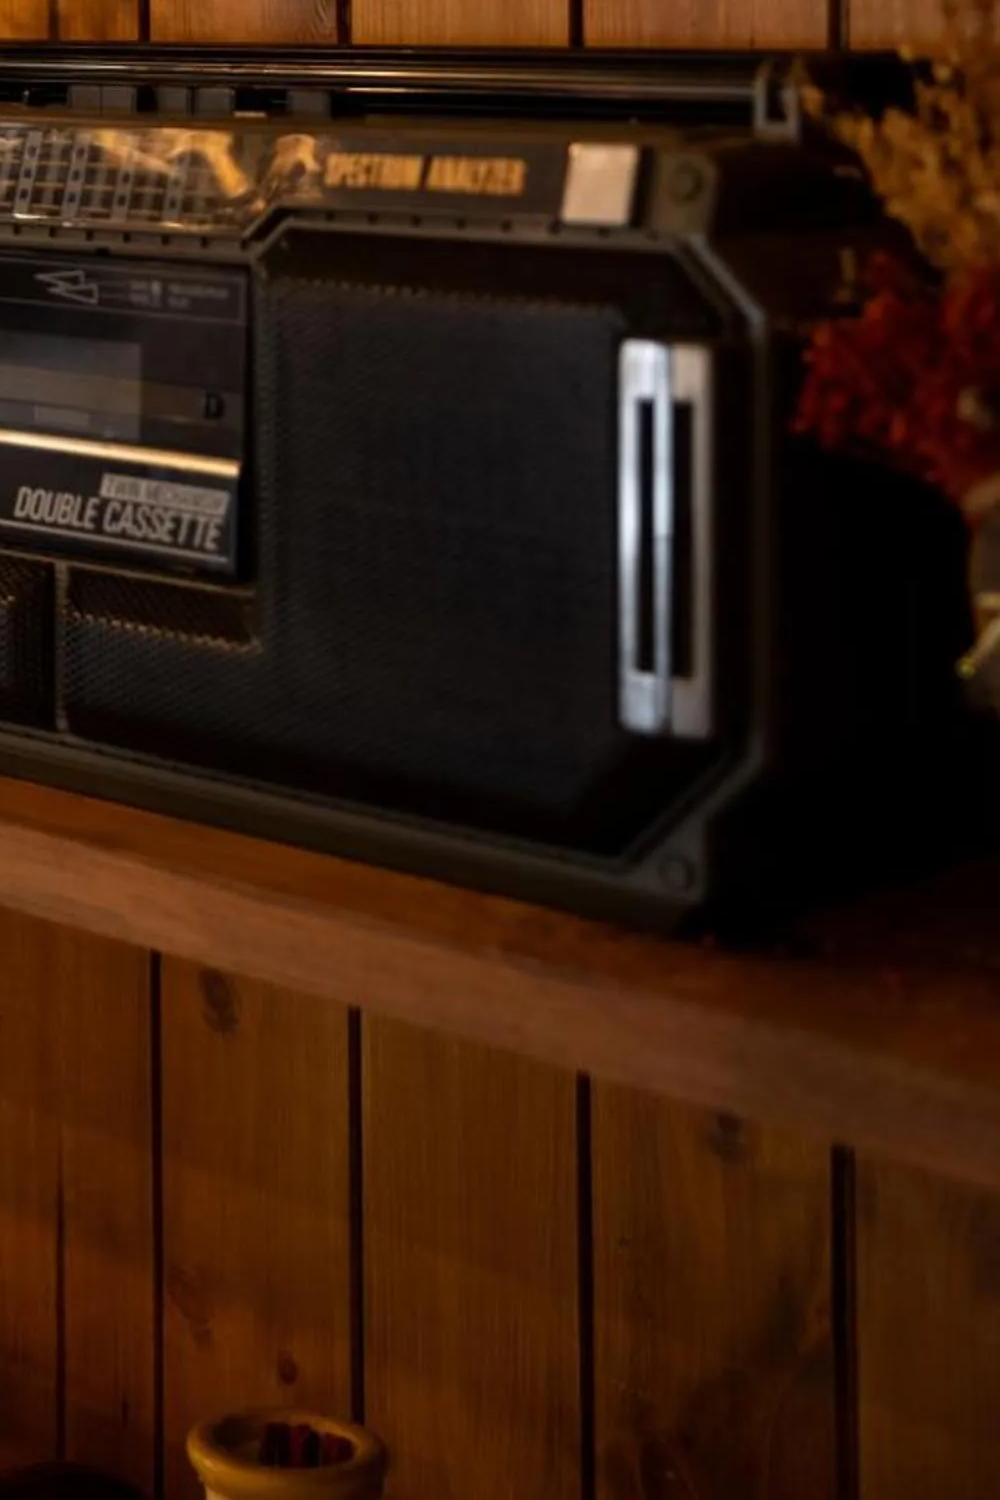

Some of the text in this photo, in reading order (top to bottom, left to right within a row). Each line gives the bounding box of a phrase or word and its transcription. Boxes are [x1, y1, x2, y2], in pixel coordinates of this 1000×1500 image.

[324, 151, 423, 190] SPECTRUM
[13, 485, 99, 530] DOUBLE
[102, 501, 224, 551] CASSETTE
